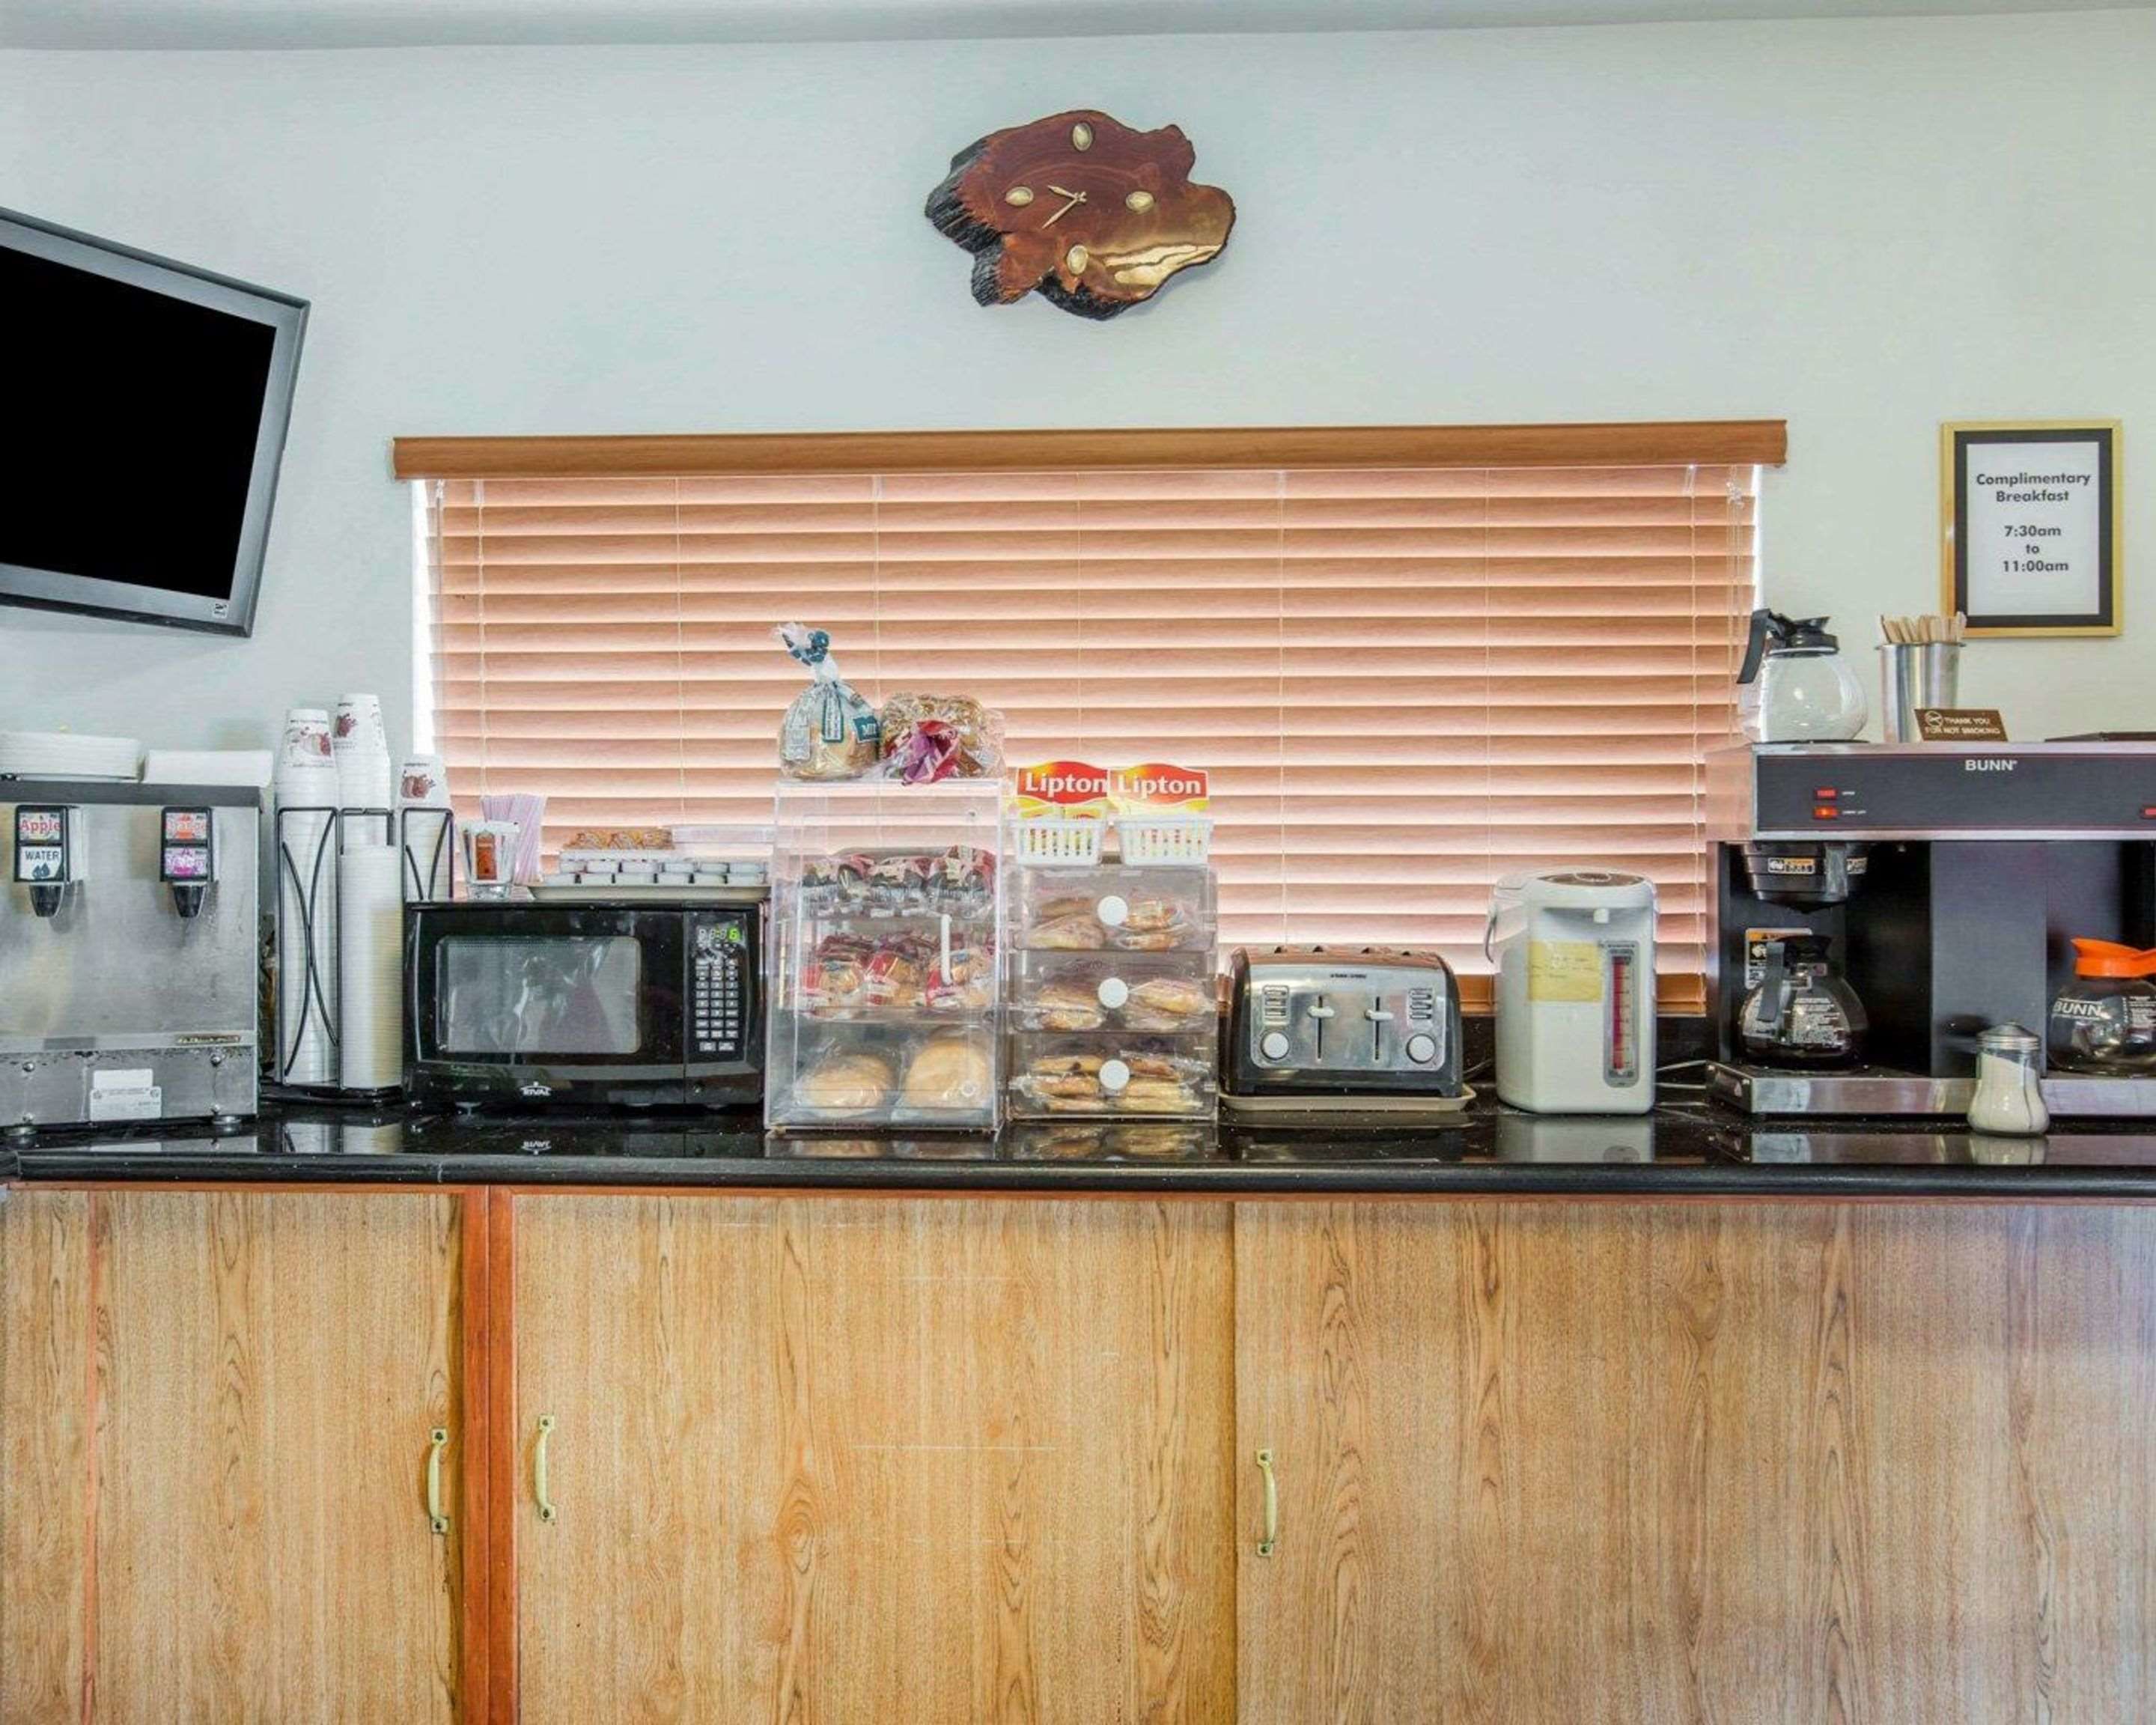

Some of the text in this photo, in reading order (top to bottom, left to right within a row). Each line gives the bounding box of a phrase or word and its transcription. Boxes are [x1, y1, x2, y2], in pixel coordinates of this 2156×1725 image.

[1976, 472, 2091, 487] Complimentary
[1996, 490, 2069, 502] Breakfast
[2004, 525, 2062, 537] 7:30am
[2026, 544, 2040, 554] to
[2003, 560, 2069, 572] 11:00am
[1944, 717, 1991, 725] THANK YOU
[1925, 726, 2001, 734] FOR NOT SMOKING
[1964, 759, 2014, 770] BUNN
[1025, 772, 1107, 798] Lipton
[1116, 774, 1202, 800] Lipton
[19, 818, 61, 834] Apple
[25, 850, 60, 861] WATER
[2053, 1001, 2102, 1016] BUNN
